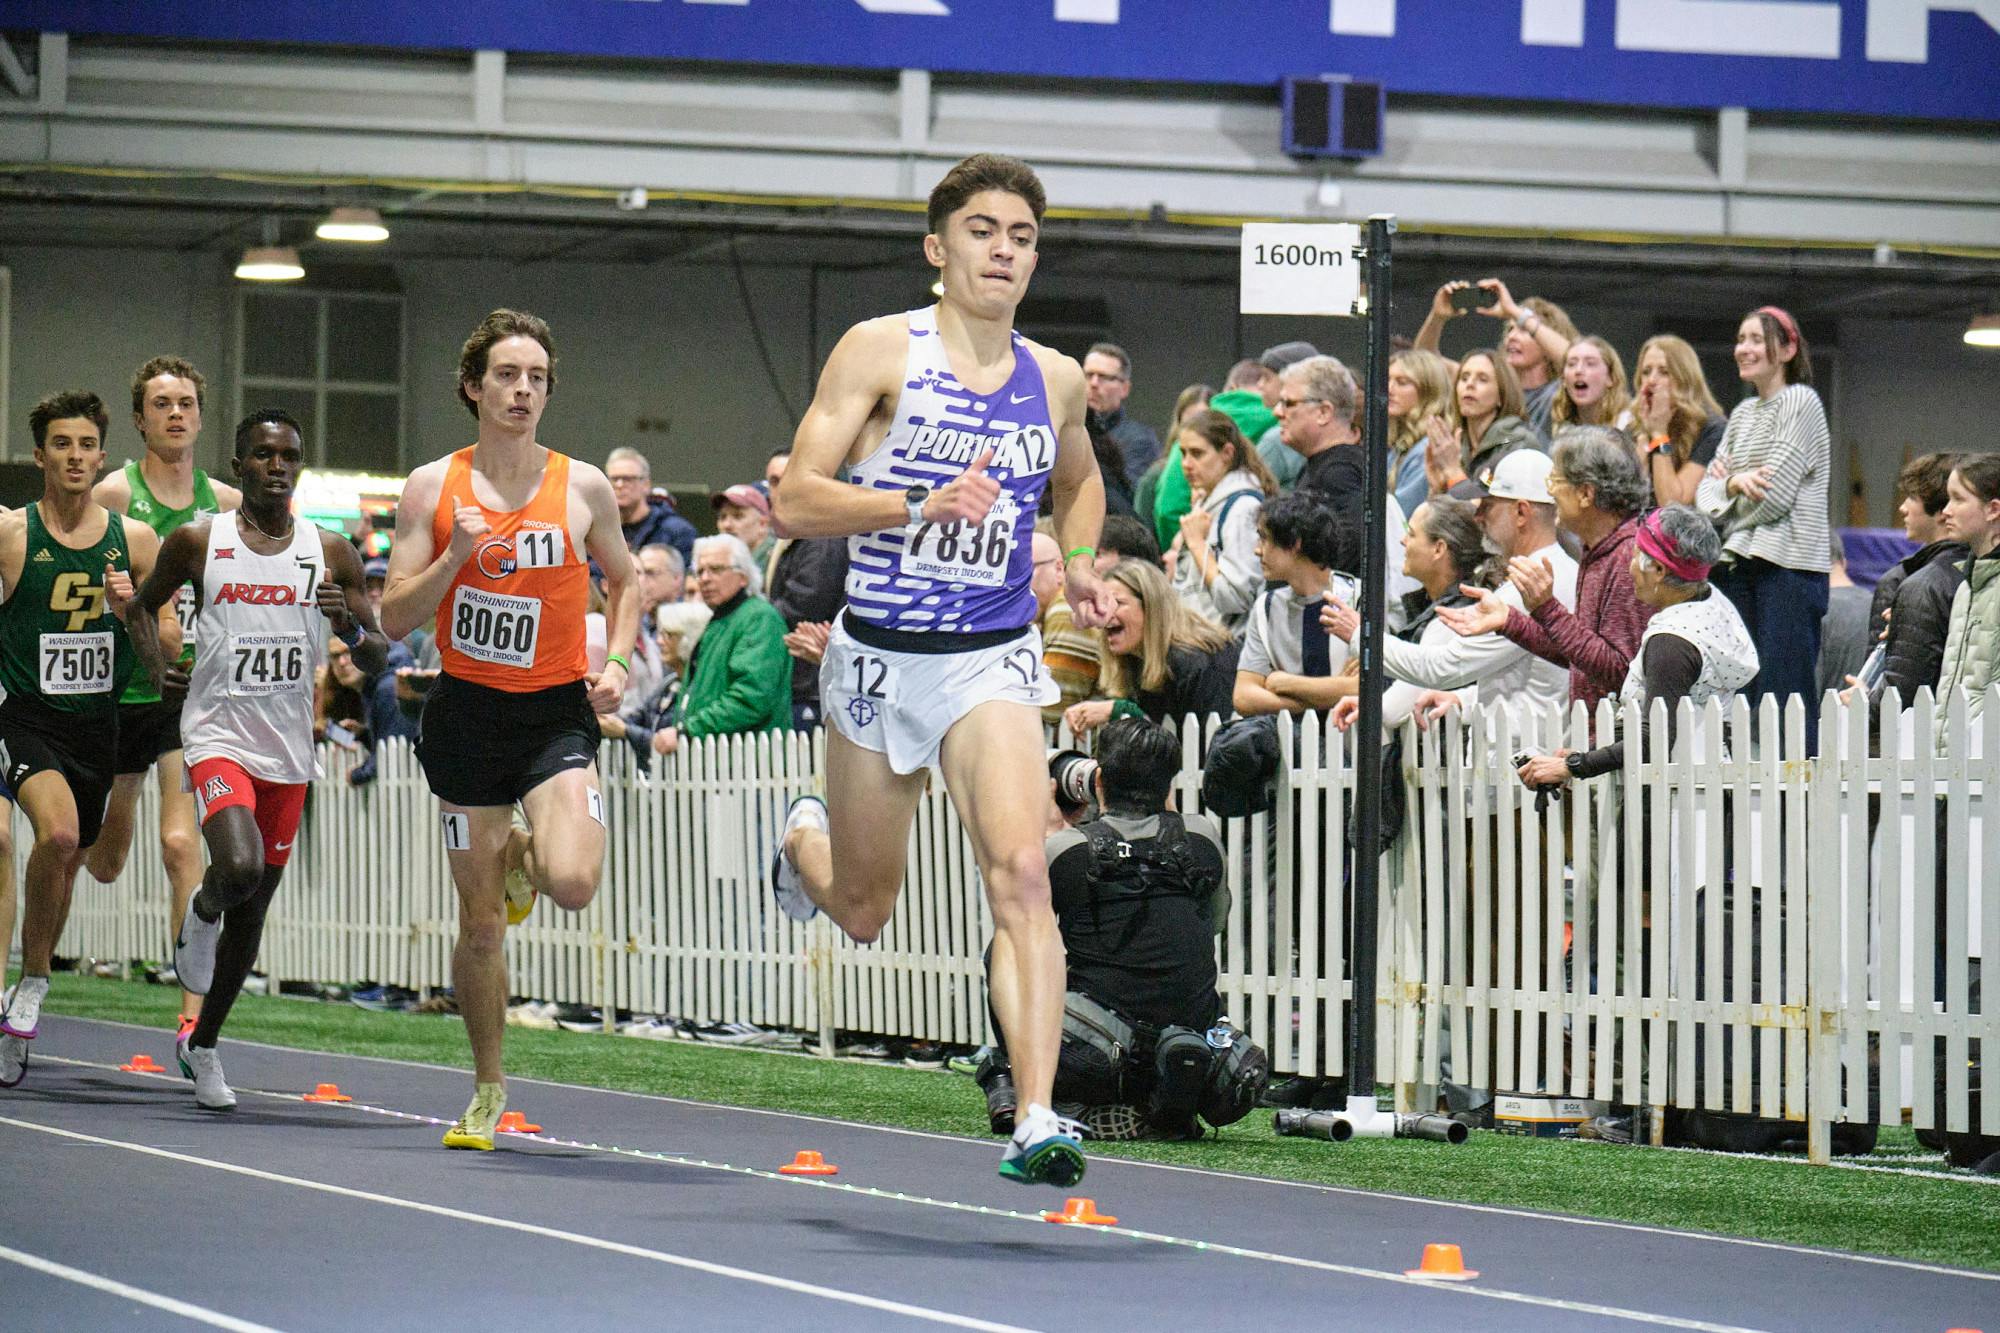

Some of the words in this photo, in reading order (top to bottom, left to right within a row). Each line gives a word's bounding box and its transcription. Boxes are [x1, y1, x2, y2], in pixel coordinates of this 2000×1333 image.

[1255, 244, 1342, 266] 1600m
[1015, 429, 1049, 473] 12
[522, 519, 560, 530] BROOKS
[523, 532, 554, 566] 11
[910, 519, 1010, 568] 7836
[299, 562, 317, 600] 7
[916, 562, 959, 576] DEMPSEY
[960, 567, 994, 580] INDOOR
[213, 582, 314, 608] ARIZO
[463, 590, 533, 611] WASHINGTON
[175, 598, 197, 631] 57
[456, 602, 535, 653] 8060
[48, 636, 108, 646] WASHINGTON
[238, 635, 299, 645] WASHINGTON
[460, 642, 492, 658] DEMPSEY
[493, 651, 523, 663] INDOOR
[45, 646, 111, 682] 7503
[235, 646, 302, 683] 7416
[852, 655, 888, 700] 12
[1003, 647, 1039, 686] 12
[51, 682, 82, 691] DEMPSEY
[82, 681, 105, 690] INDOOR
[240, 684, 271, 692] DEMPSEY
[272, 683, 296, 691] INDOOR
